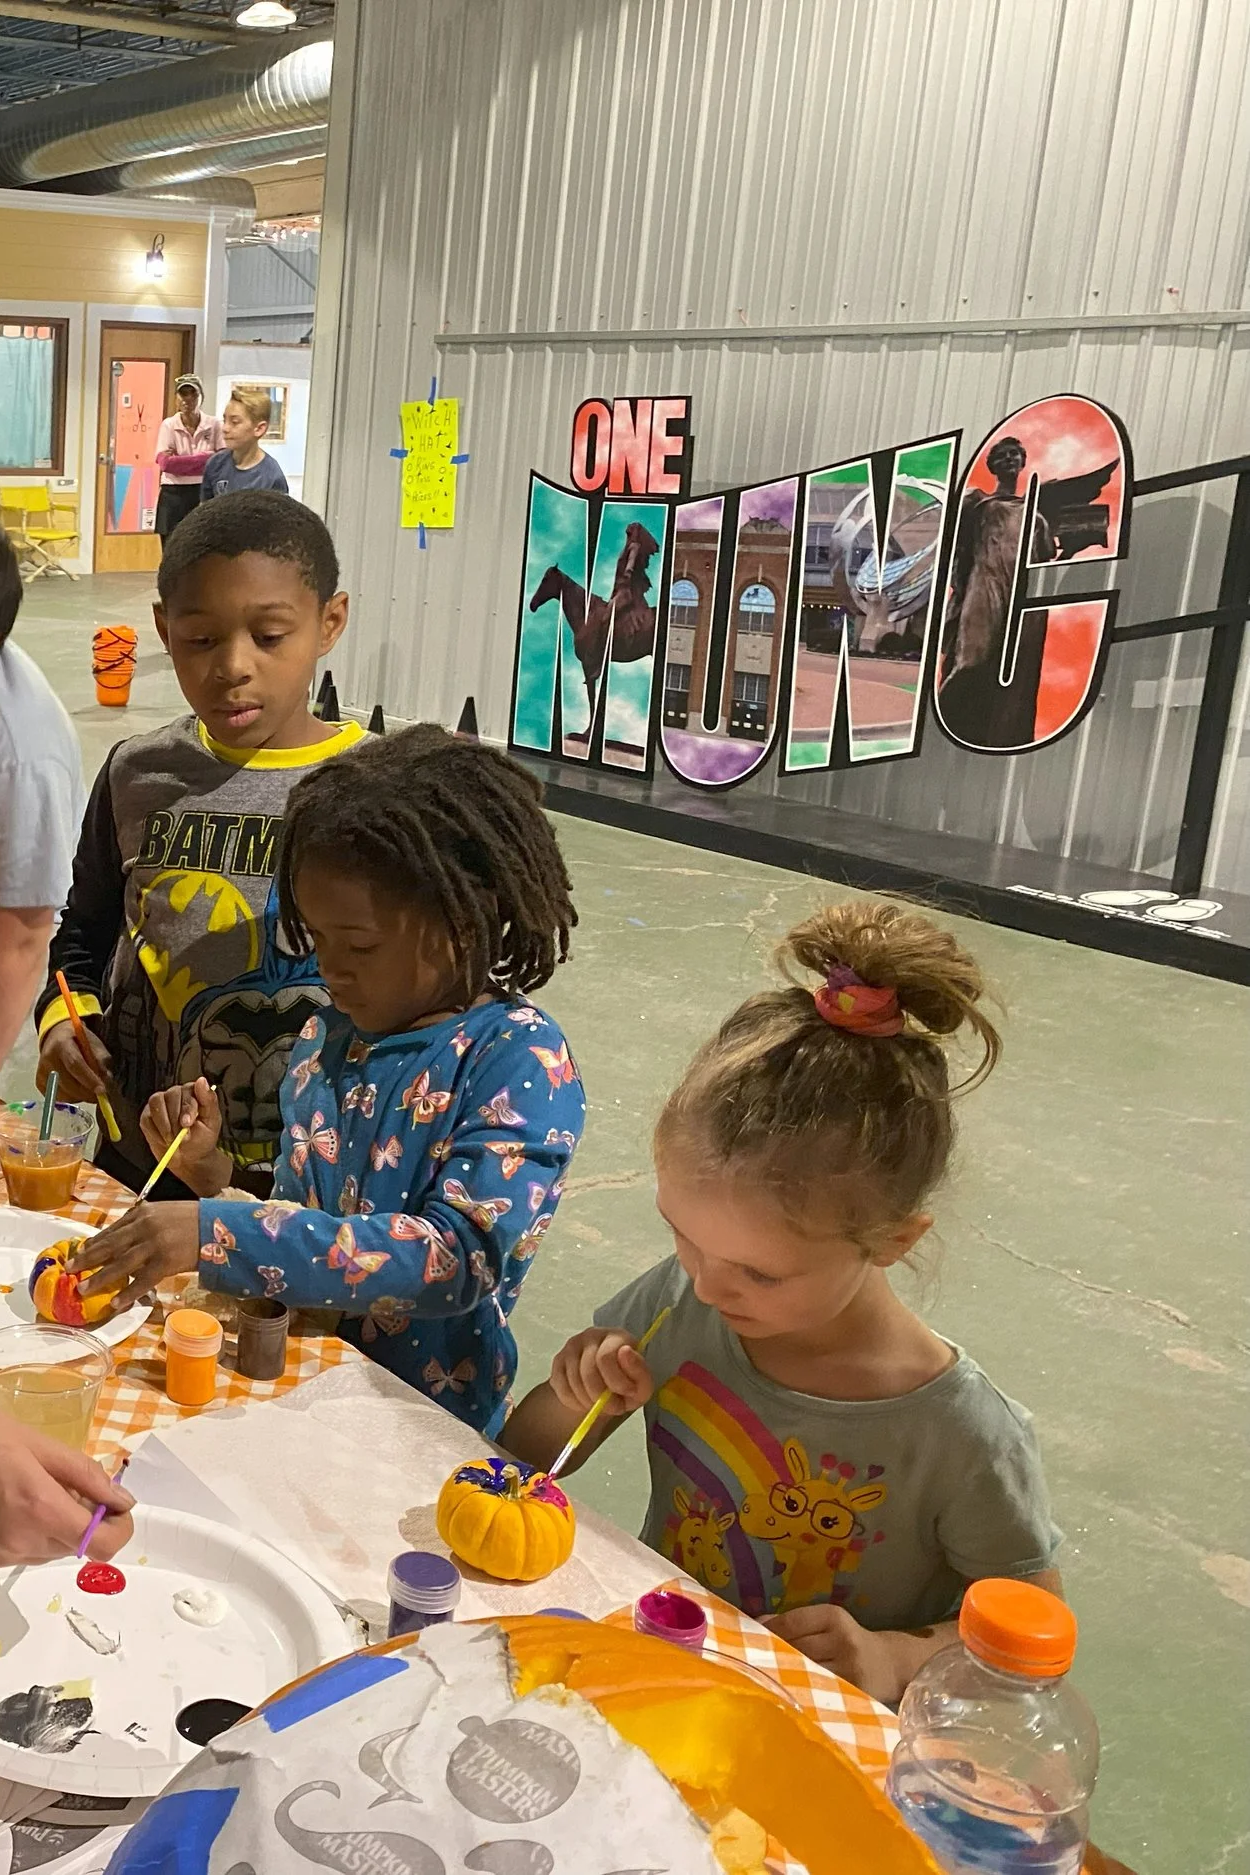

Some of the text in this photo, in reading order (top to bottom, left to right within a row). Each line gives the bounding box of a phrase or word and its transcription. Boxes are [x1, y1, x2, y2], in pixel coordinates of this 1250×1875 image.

[571, 396, 692, 496] ONE
[508, 393, 1135, 791] MUNC
[134, 811, 285, 878] BATM
[469, 1743, 559, 1811] PUMPKIN
[519, 1725, 579, 1770] MAST
[453, 1758, 540, 1820] MASTERS
